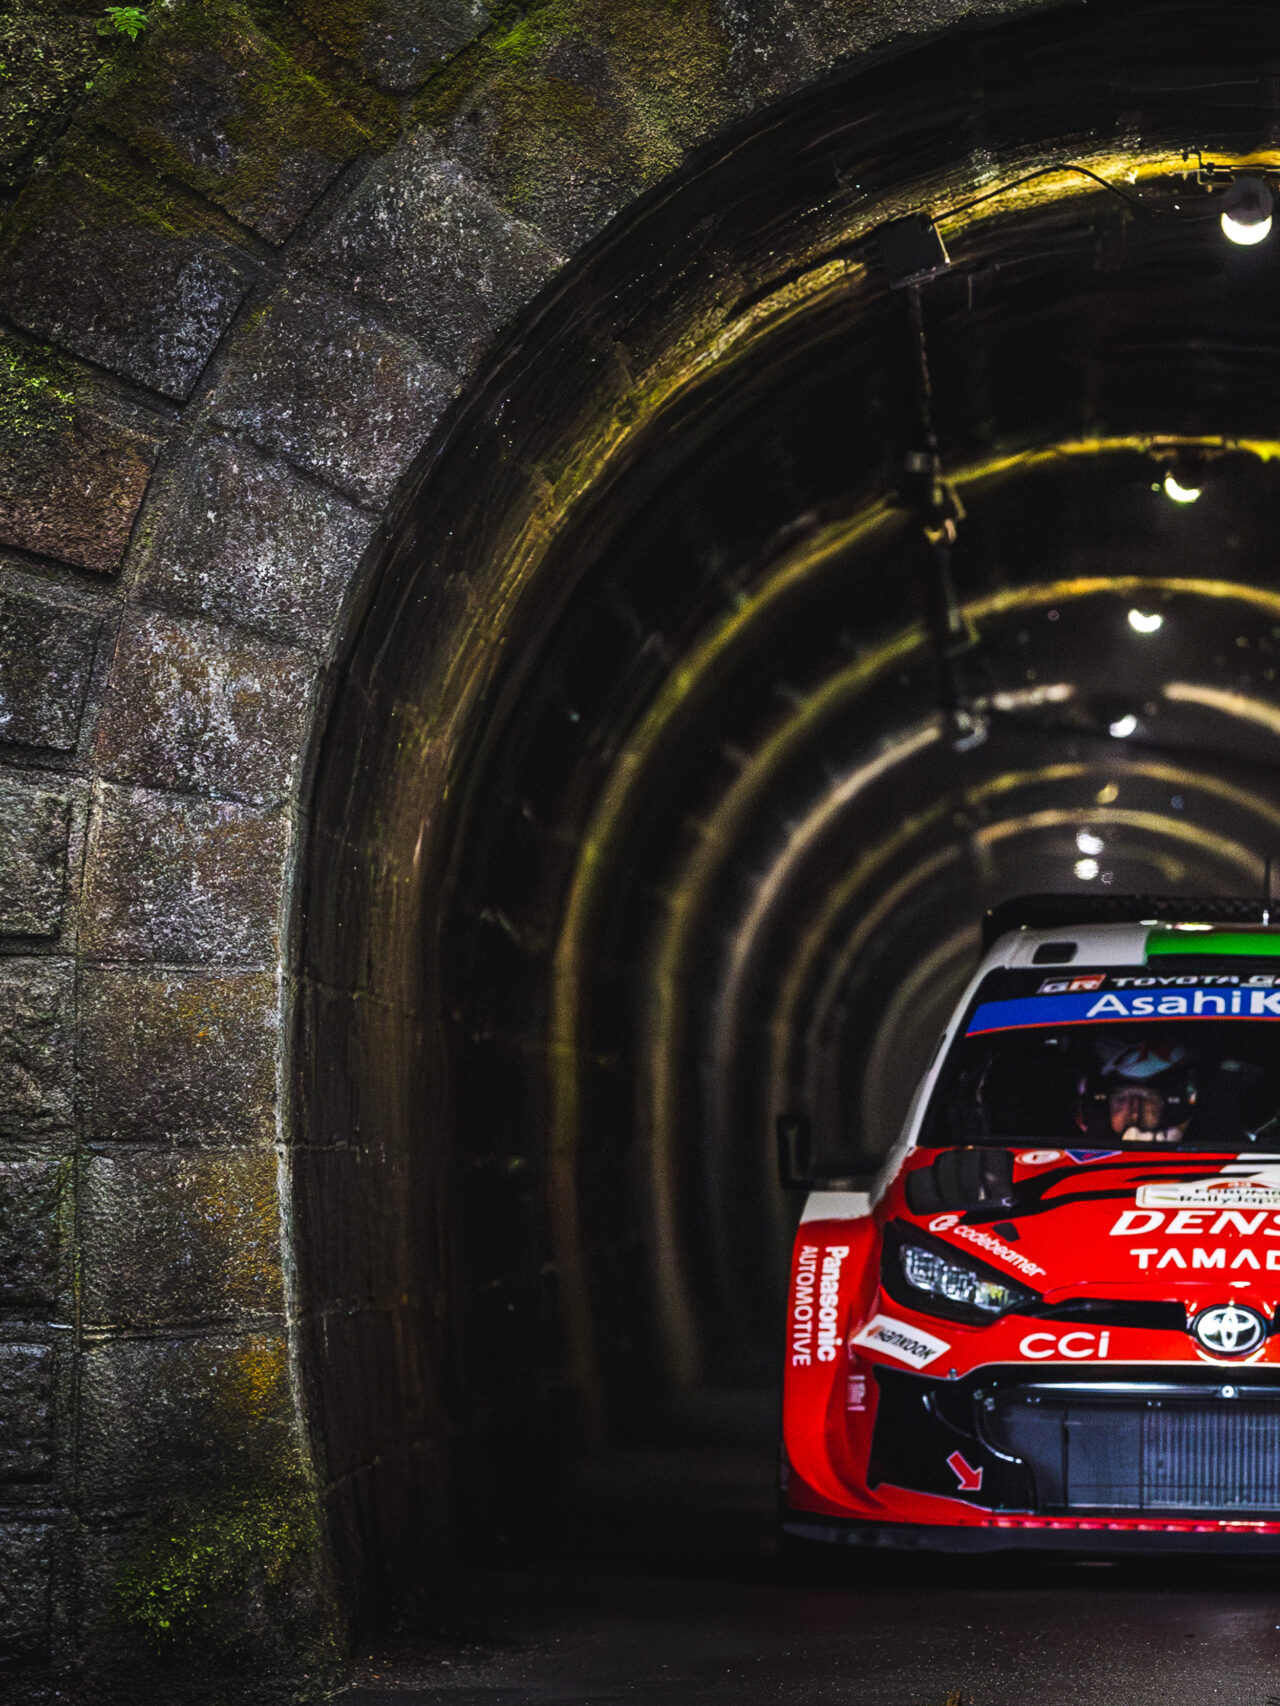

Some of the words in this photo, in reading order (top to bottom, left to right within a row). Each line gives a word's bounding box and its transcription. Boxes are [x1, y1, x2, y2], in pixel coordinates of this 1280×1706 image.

[1040, 979, 1101, 994] GR
[1111, 975, 1240, 987] TOYOTA
[953, 1225, 1047, 1276] codebeamer
[792, 1245, 819, 1367] AUTOMOTIVE
[817, 1246, 850, 1362] Panasonic
